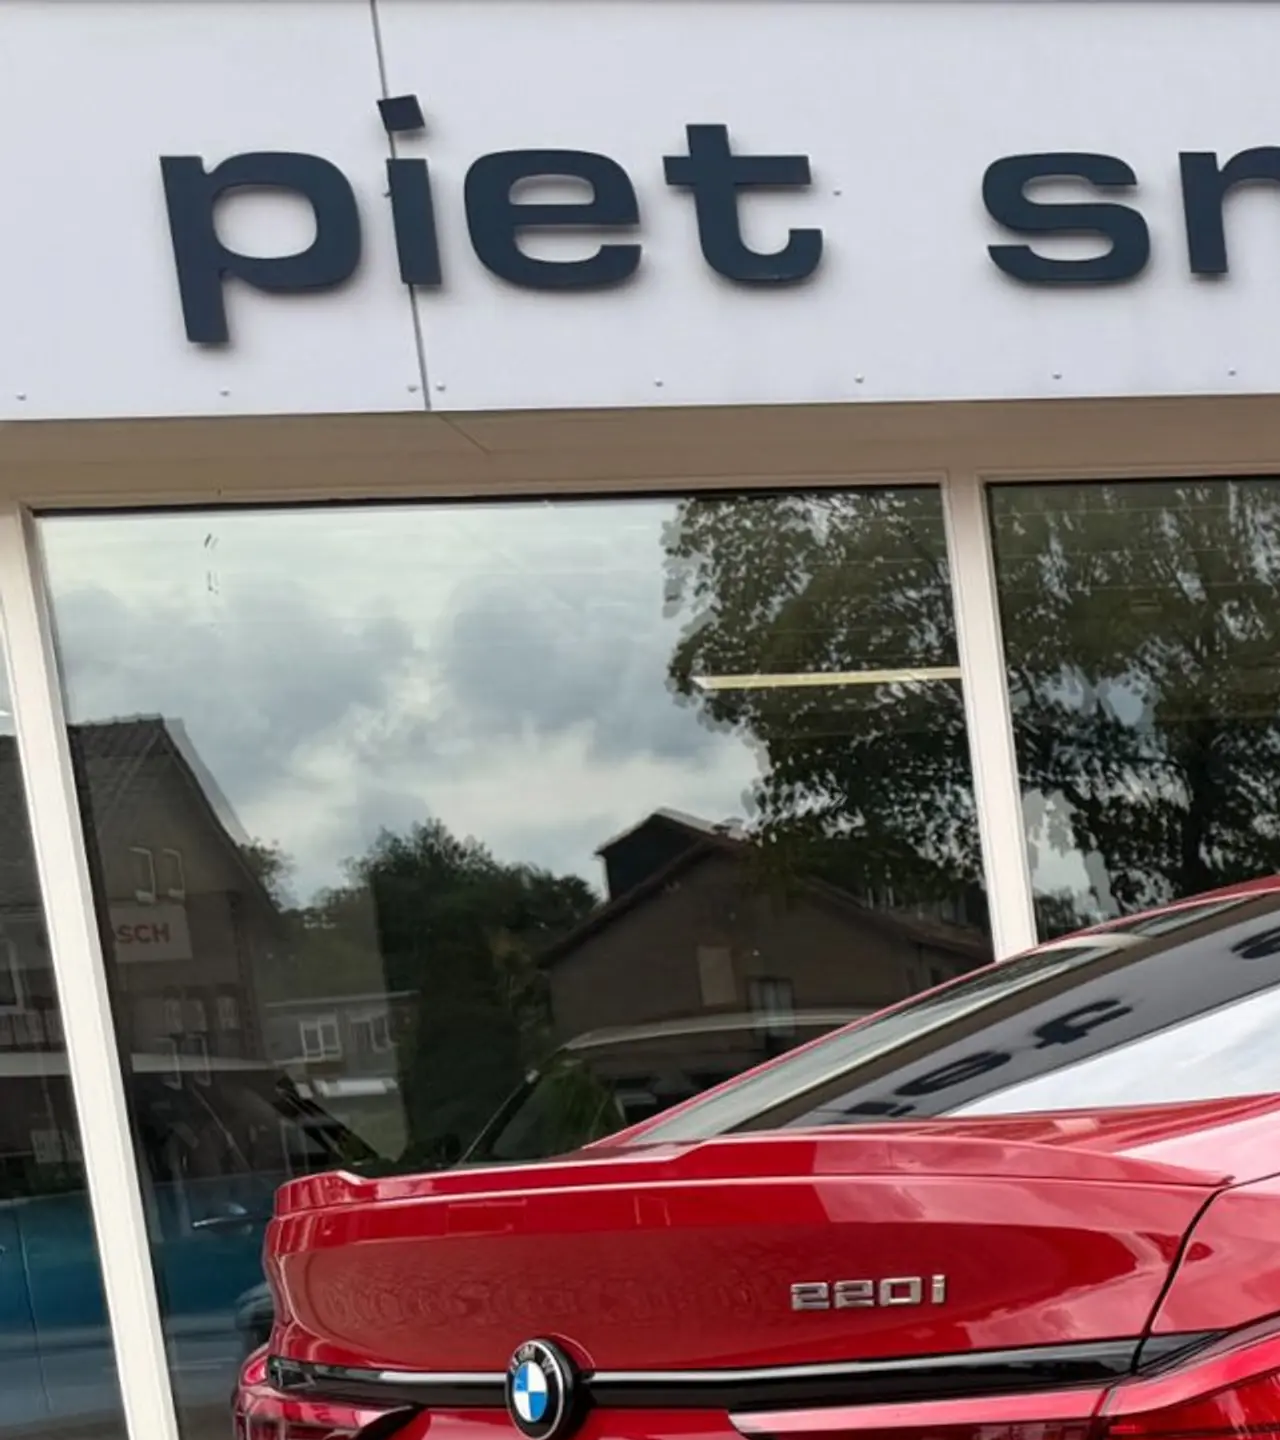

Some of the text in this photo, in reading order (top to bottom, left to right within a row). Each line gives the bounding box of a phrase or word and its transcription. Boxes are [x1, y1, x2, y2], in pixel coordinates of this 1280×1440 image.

[160, 94, 824, 345] piet
[116, 922, 170, 944] SCH
[790, 1274, 946, 1311] 220i
